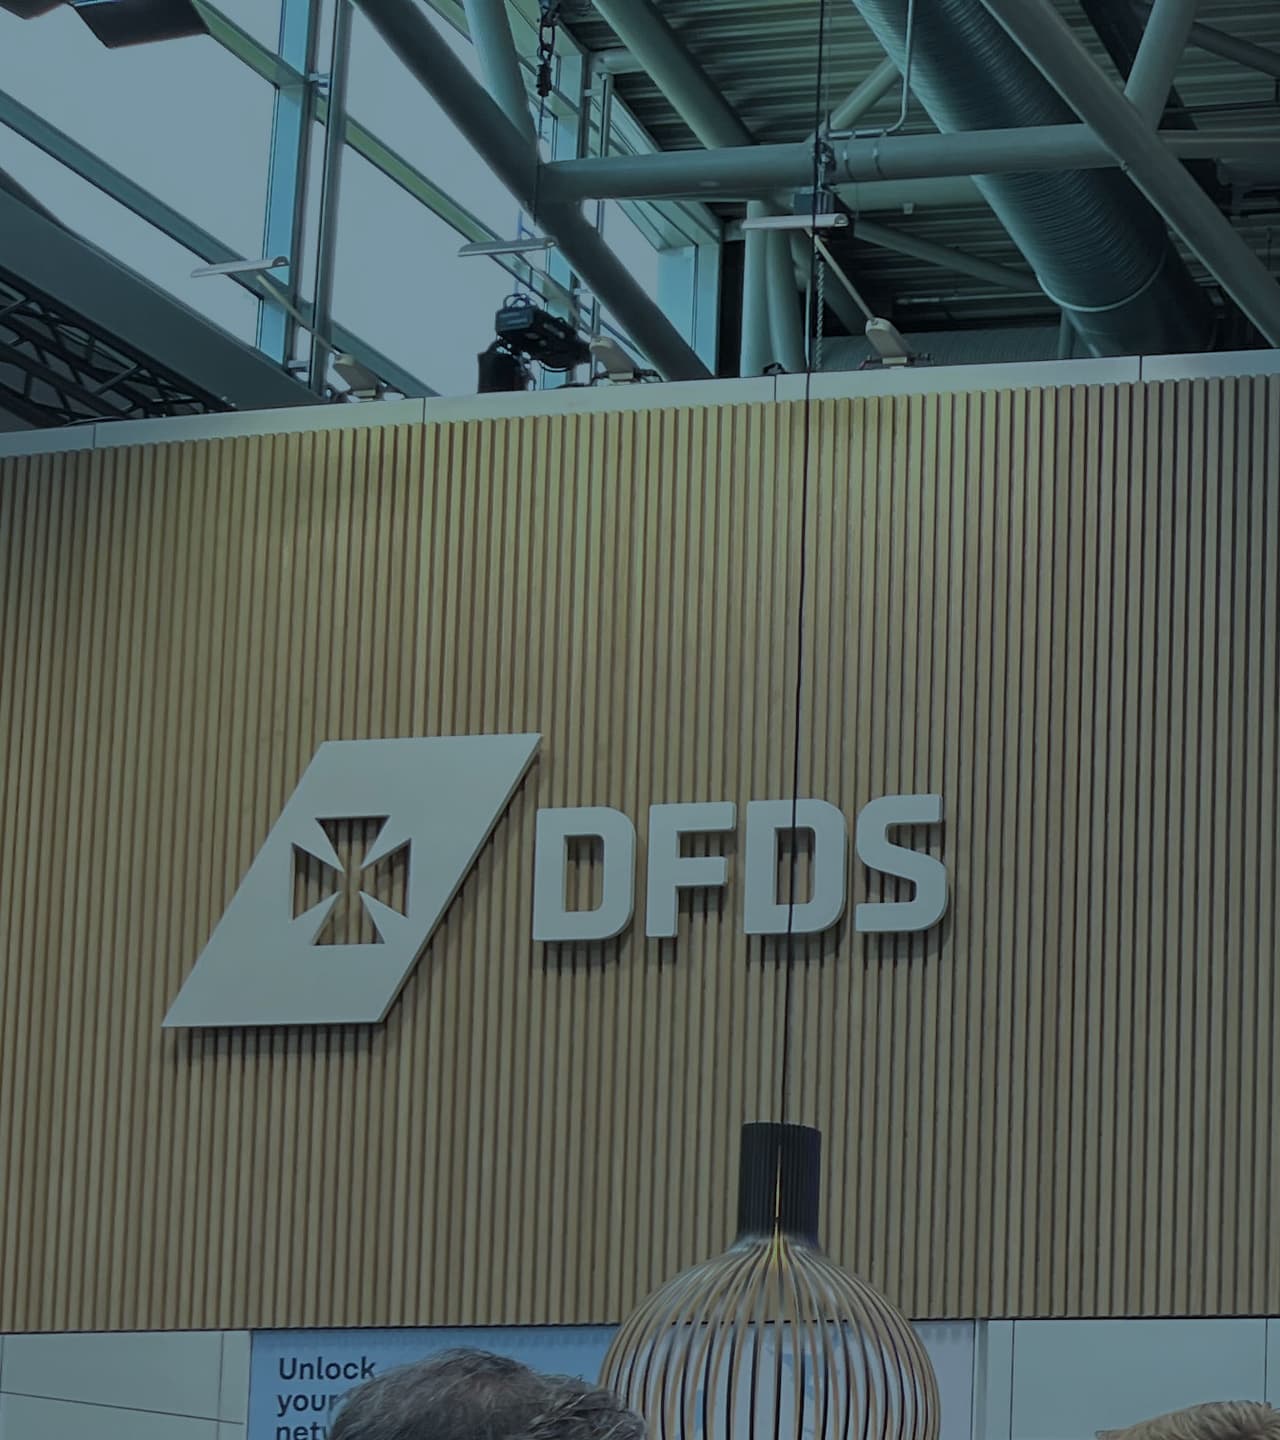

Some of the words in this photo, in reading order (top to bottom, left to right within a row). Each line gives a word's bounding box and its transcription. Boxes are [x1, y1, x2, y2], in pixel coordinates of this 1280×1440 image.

[532, 794, 949, 942] DFDS
[279, 1356, 376, 1380] Unlock
[277, 1394, 338, 1417] your
